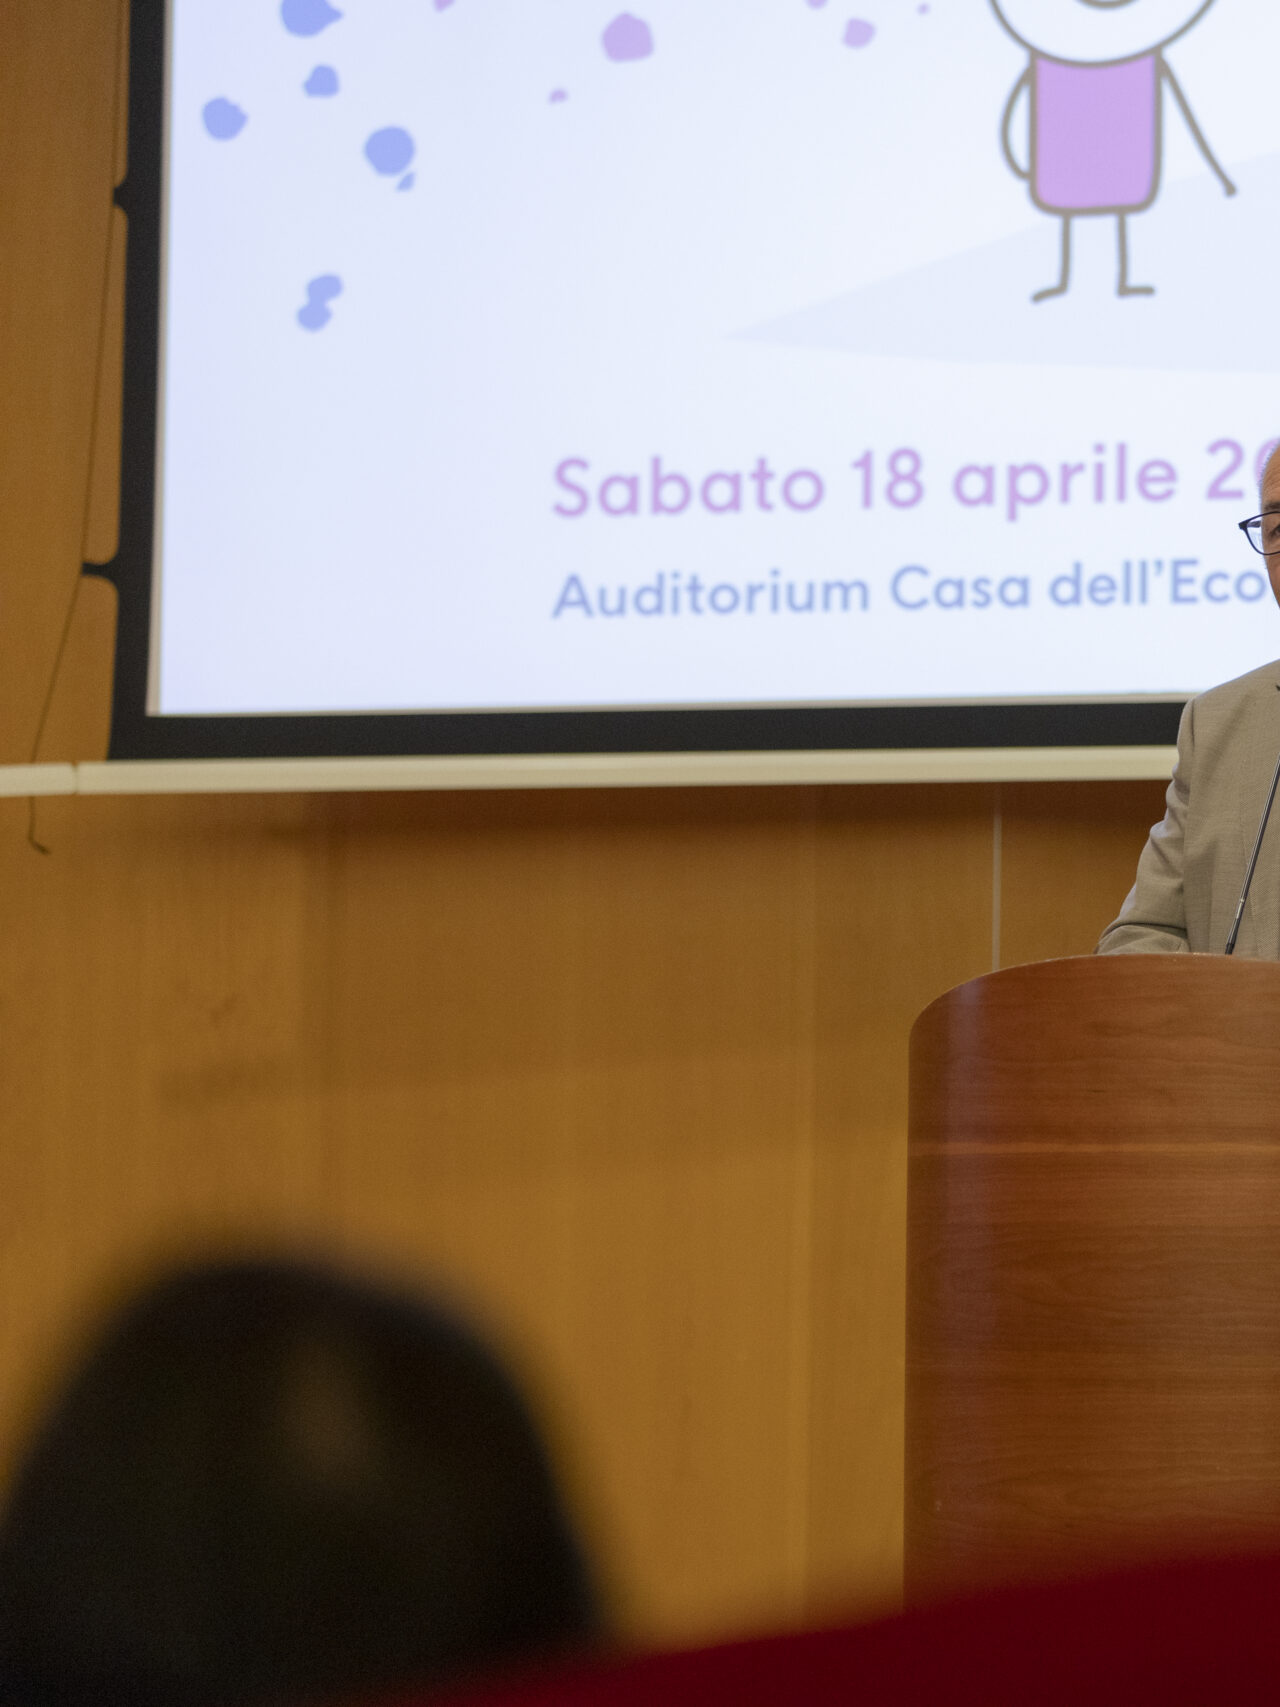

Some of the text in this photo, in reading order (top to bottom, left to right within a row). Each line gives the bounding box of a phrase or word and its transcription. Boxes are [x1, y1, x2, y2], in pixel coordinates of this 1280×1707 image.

[551, 455, 826, 519] Sabato
[851, 447, 925, 510] 18
[951, 441, 1178, 523] aprile
[551, 567, 870, 620] Auditorium
[889, 564, 1030, 611] Casa
[1048, 556, 1270, 608] dell’Eco
